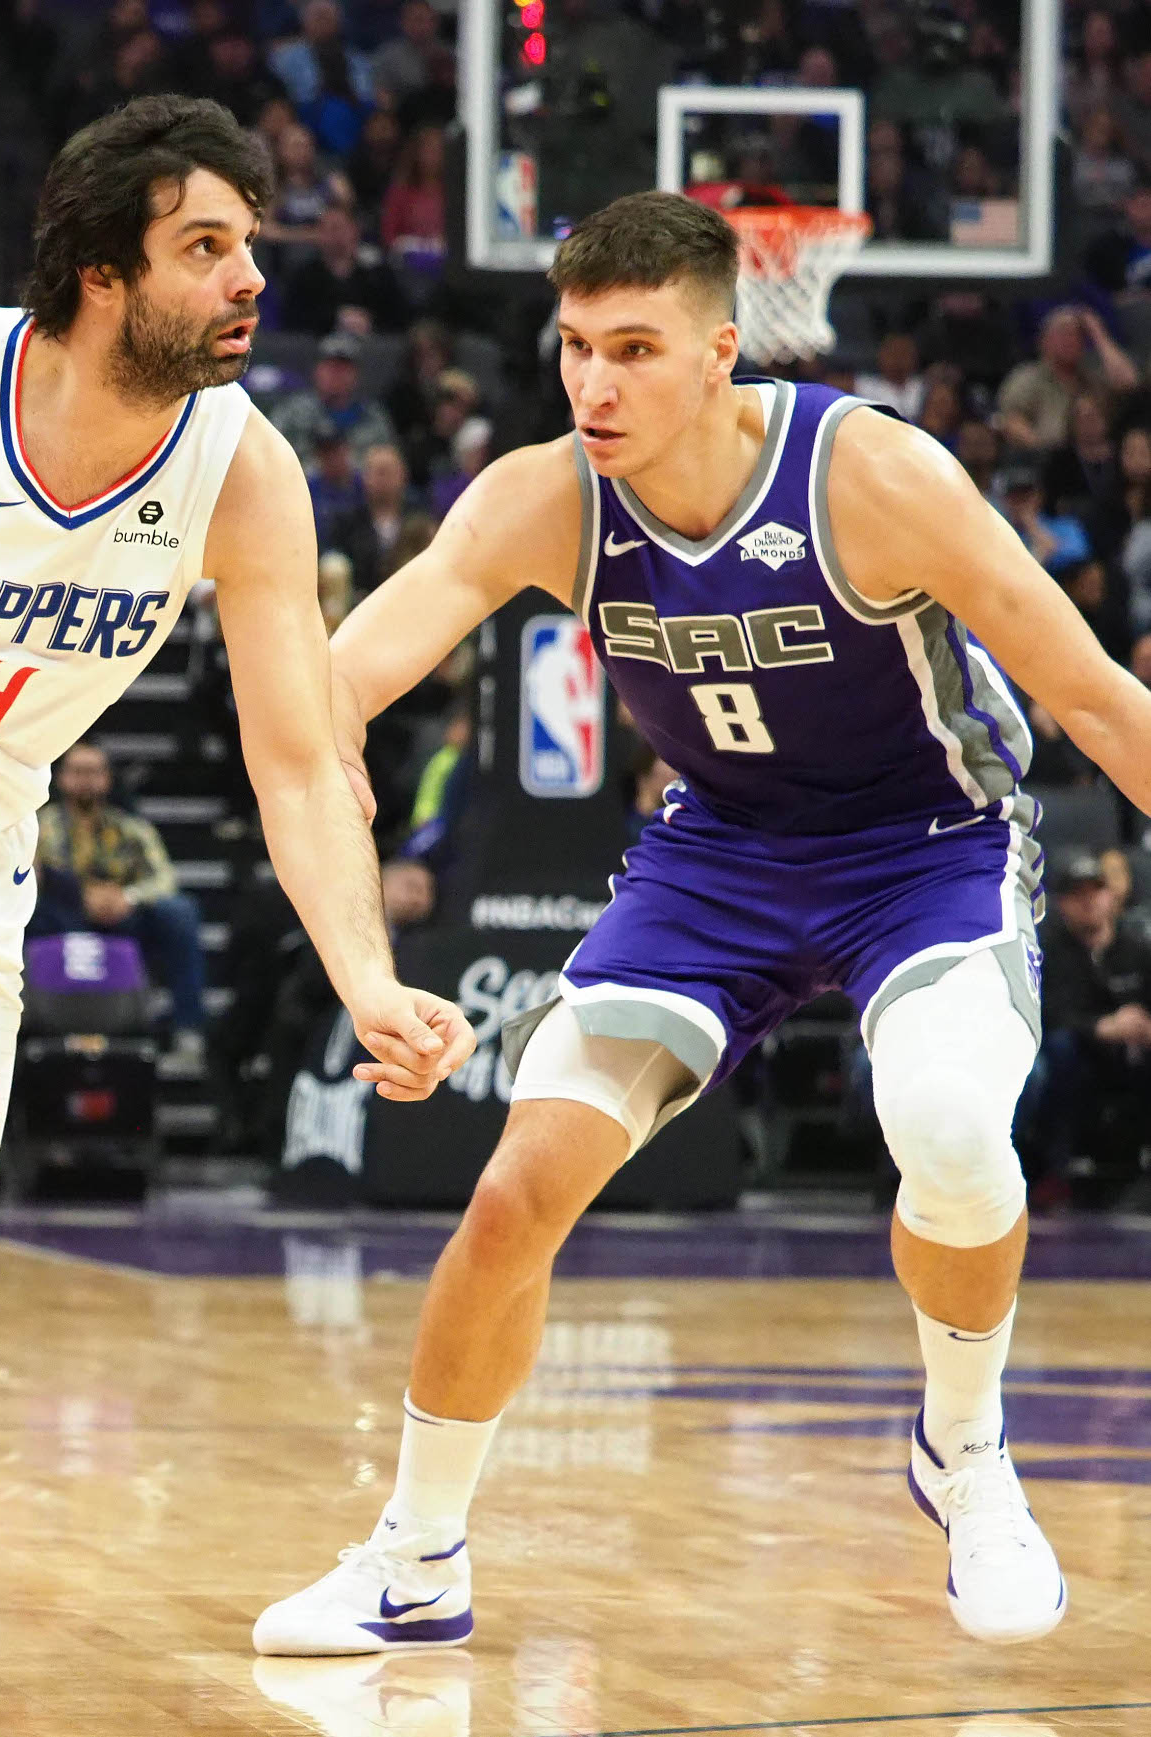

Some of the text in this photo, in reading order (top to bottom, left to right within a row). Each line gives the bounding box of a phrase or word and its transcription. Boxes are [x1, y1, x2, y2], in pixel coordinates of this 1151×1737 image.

[113, 528, 180, 549] bumble
[754, 537, 793, 547] DIAMOND
[743, 549, 803, 560] ALMONDS
[598, 601, 834, 674] SAC
[689, 682, 776, 755] 8
